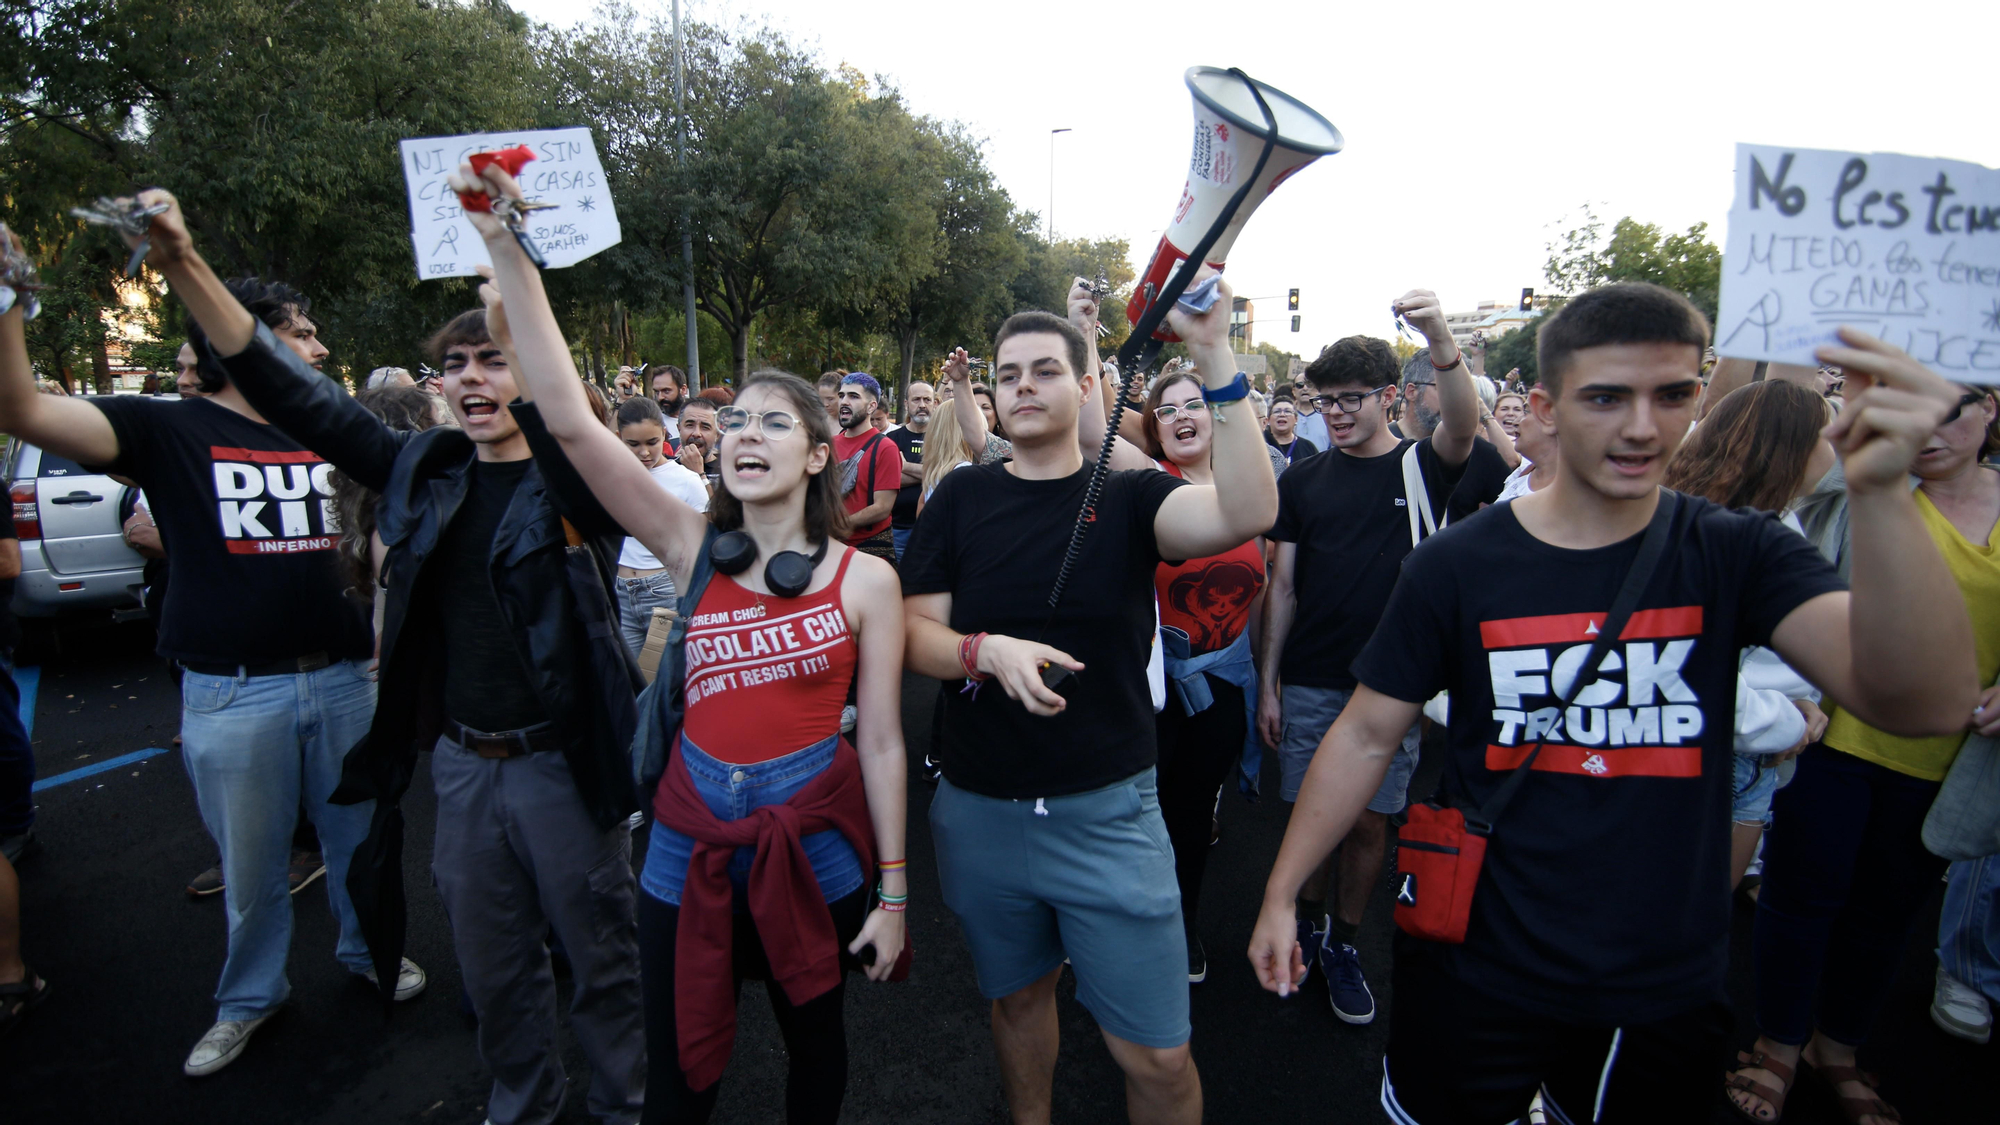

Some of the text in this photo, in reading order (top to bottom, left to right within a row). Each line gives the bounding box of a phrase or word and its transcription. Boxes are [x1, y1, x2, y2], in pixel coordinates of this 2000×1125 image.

[413, 149, 447, 175] NI
[540, 141, 581, 162] SIN
[1196, 119, 1204, 175] CONTRA EL
[1202, 126, 1211, 180] FASCISMO
[534, 171, 597, 191] CASAS
[1749, 152, 1806, 217] No
[1832, 156, 1910, 230] les
[533, 223, 577, 240] SOMOS
[540, 234, 589, 254] CARMEN
[1930, 240, 2000, 287] tene
[258, 538, 331, 552] INFERNO
[692, 612, 730, 627] CREAM
[685, 622, 801, 679] HOCOLATE
[701, 672, 738, 697] CAN'T
[740, 661, 797, 687] RESIST
[801, 653, 830, 675] IT!!
[1488, 638, 1699, 709] FCK
[1492, 704, 1703, 745] TRUMP
